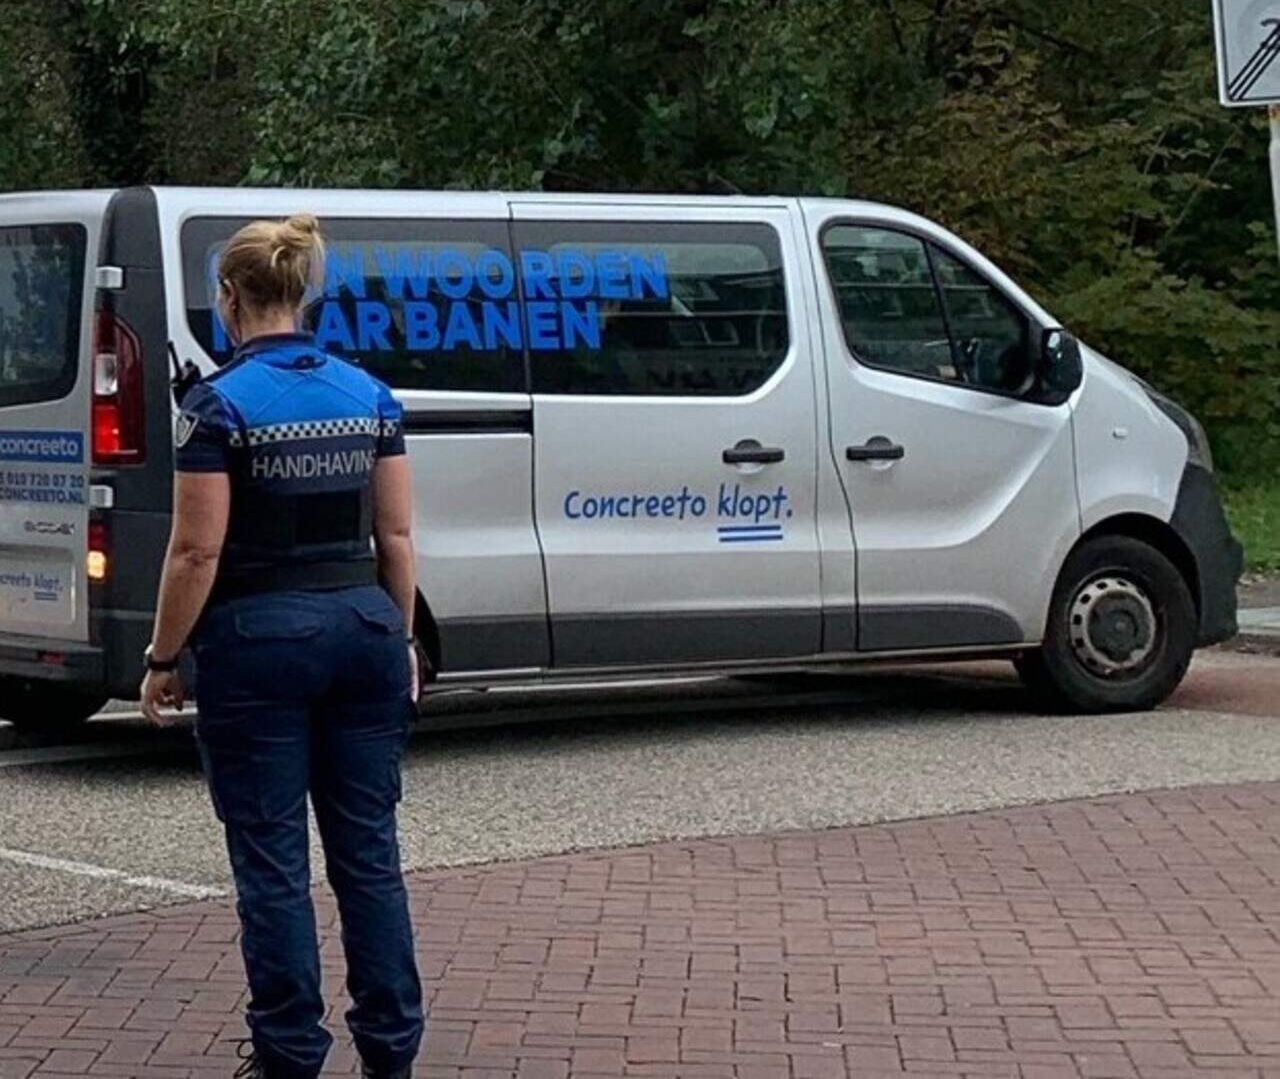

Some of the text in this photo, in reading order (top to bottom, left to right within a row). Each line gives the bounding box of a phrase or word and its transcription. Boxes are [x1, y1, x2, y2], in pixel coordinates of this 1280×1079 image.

[377, 248, 668, 300] WOORDEN
[405, 300, 602, 352] BANEN
[0, 437, 78, 456] concreeto
[564, 483, 793, 523] Concreeto klopt.
